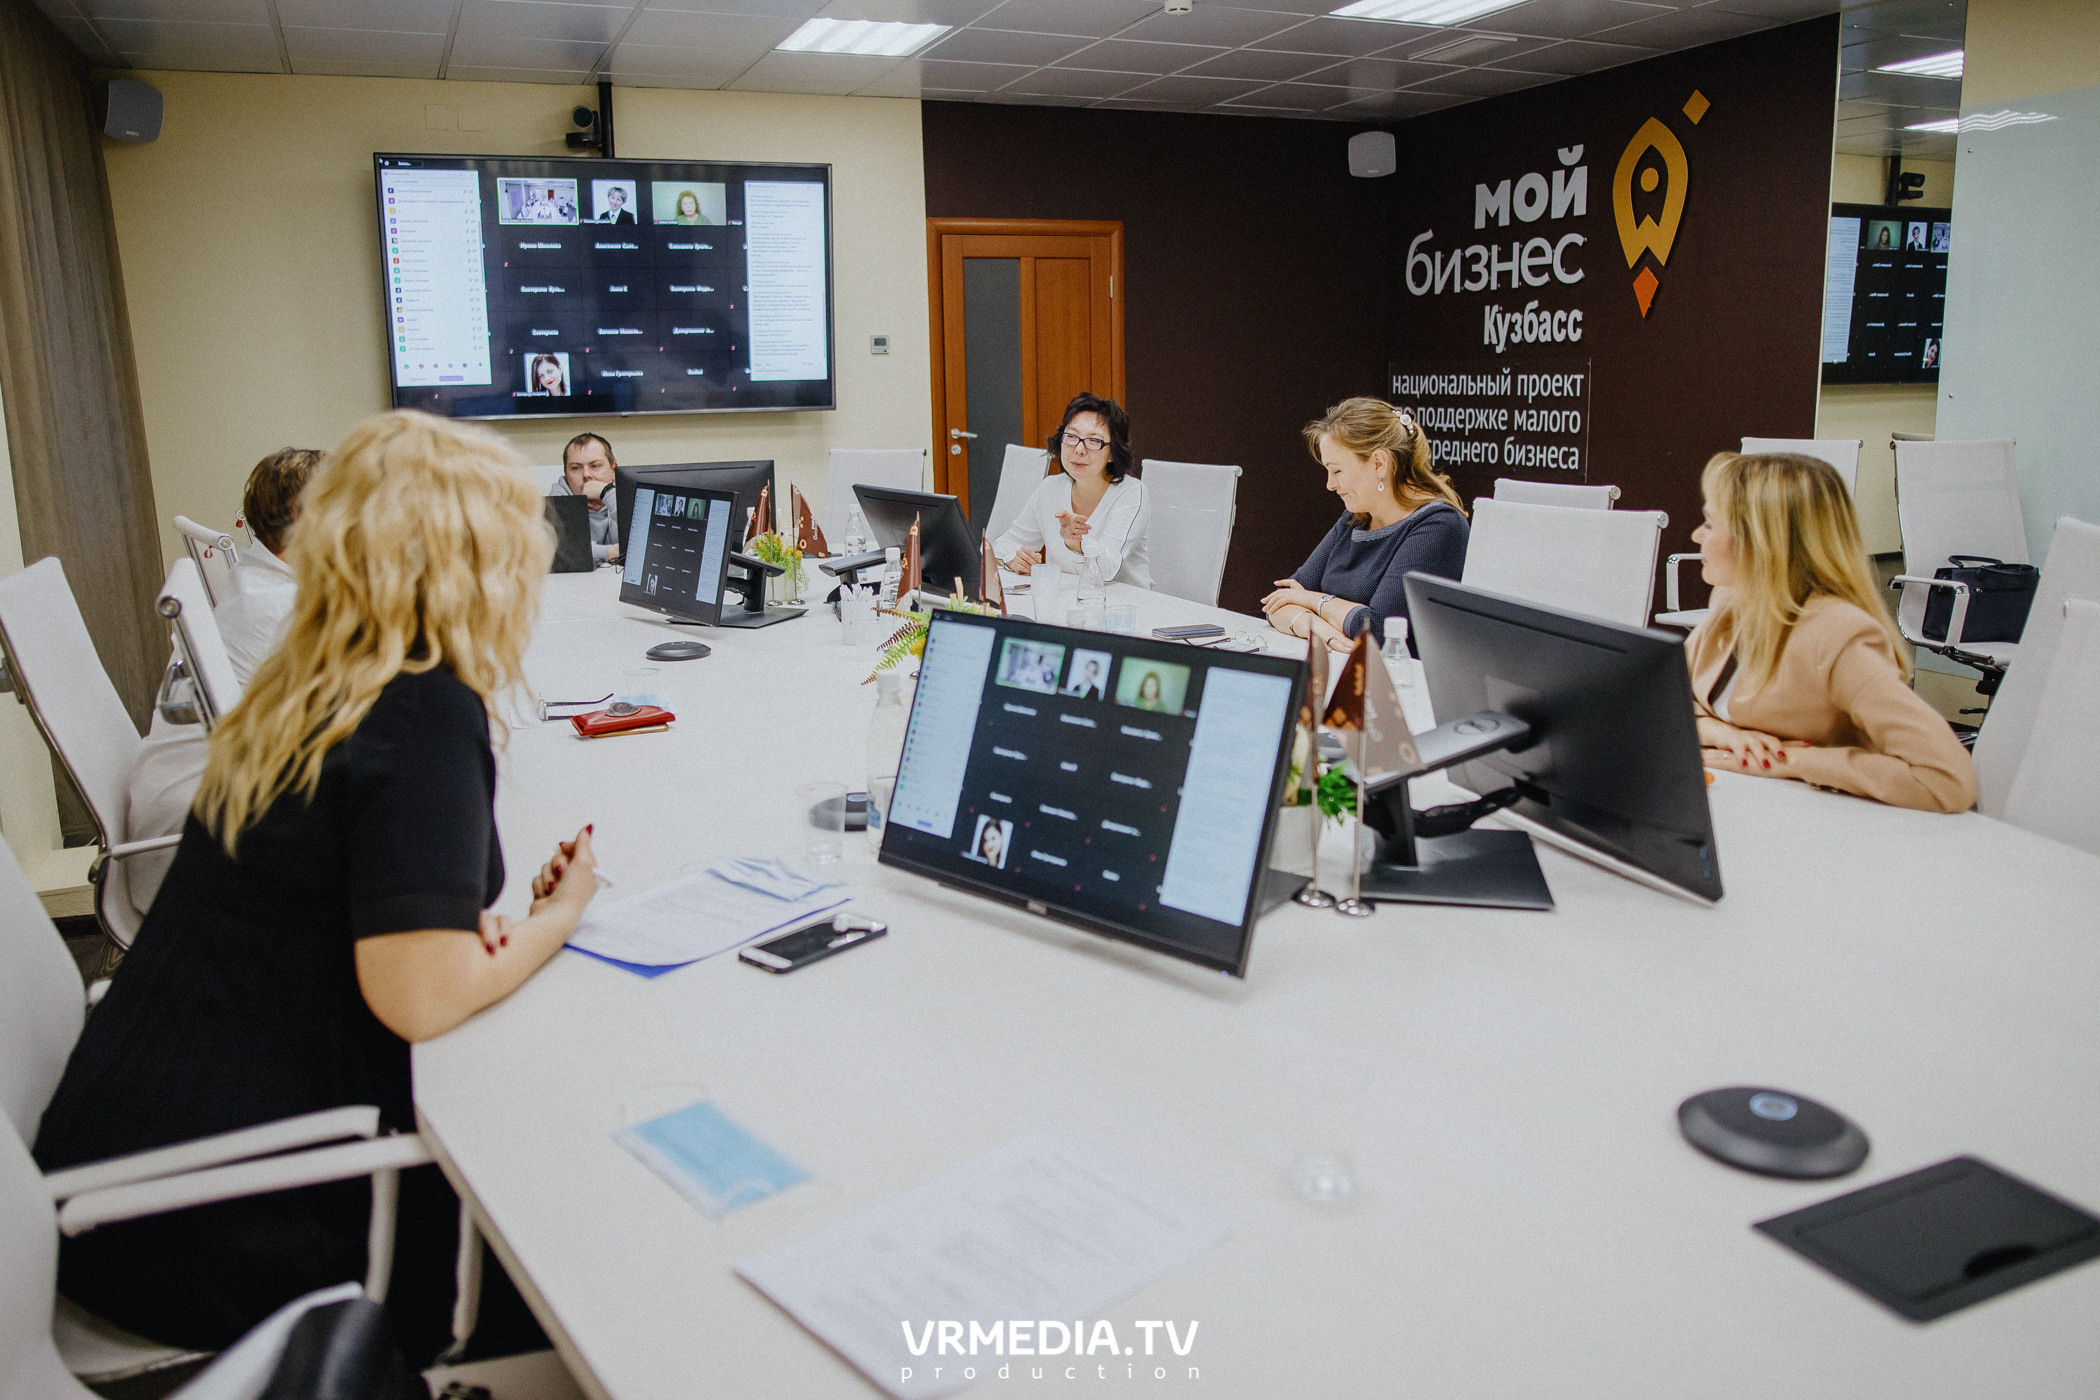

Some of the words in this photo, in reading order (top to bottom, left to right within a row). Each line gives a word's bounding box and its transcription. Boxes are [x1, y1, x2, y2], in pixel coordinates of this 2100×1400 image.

[1475, 144, 1587, 229] мой
[1406, 228, 1587, 295] бизнес
[1484, 300, 1583, 353] Кузбасс
[1393, 368, 1511, 398] национальный
[1518, 374, 1584, 403] проект
[1417, 407, 1508, 436] поддержке
[1514, 410, 1580, 433] малого
[1504, 436, 1579, 469] бизнеса
